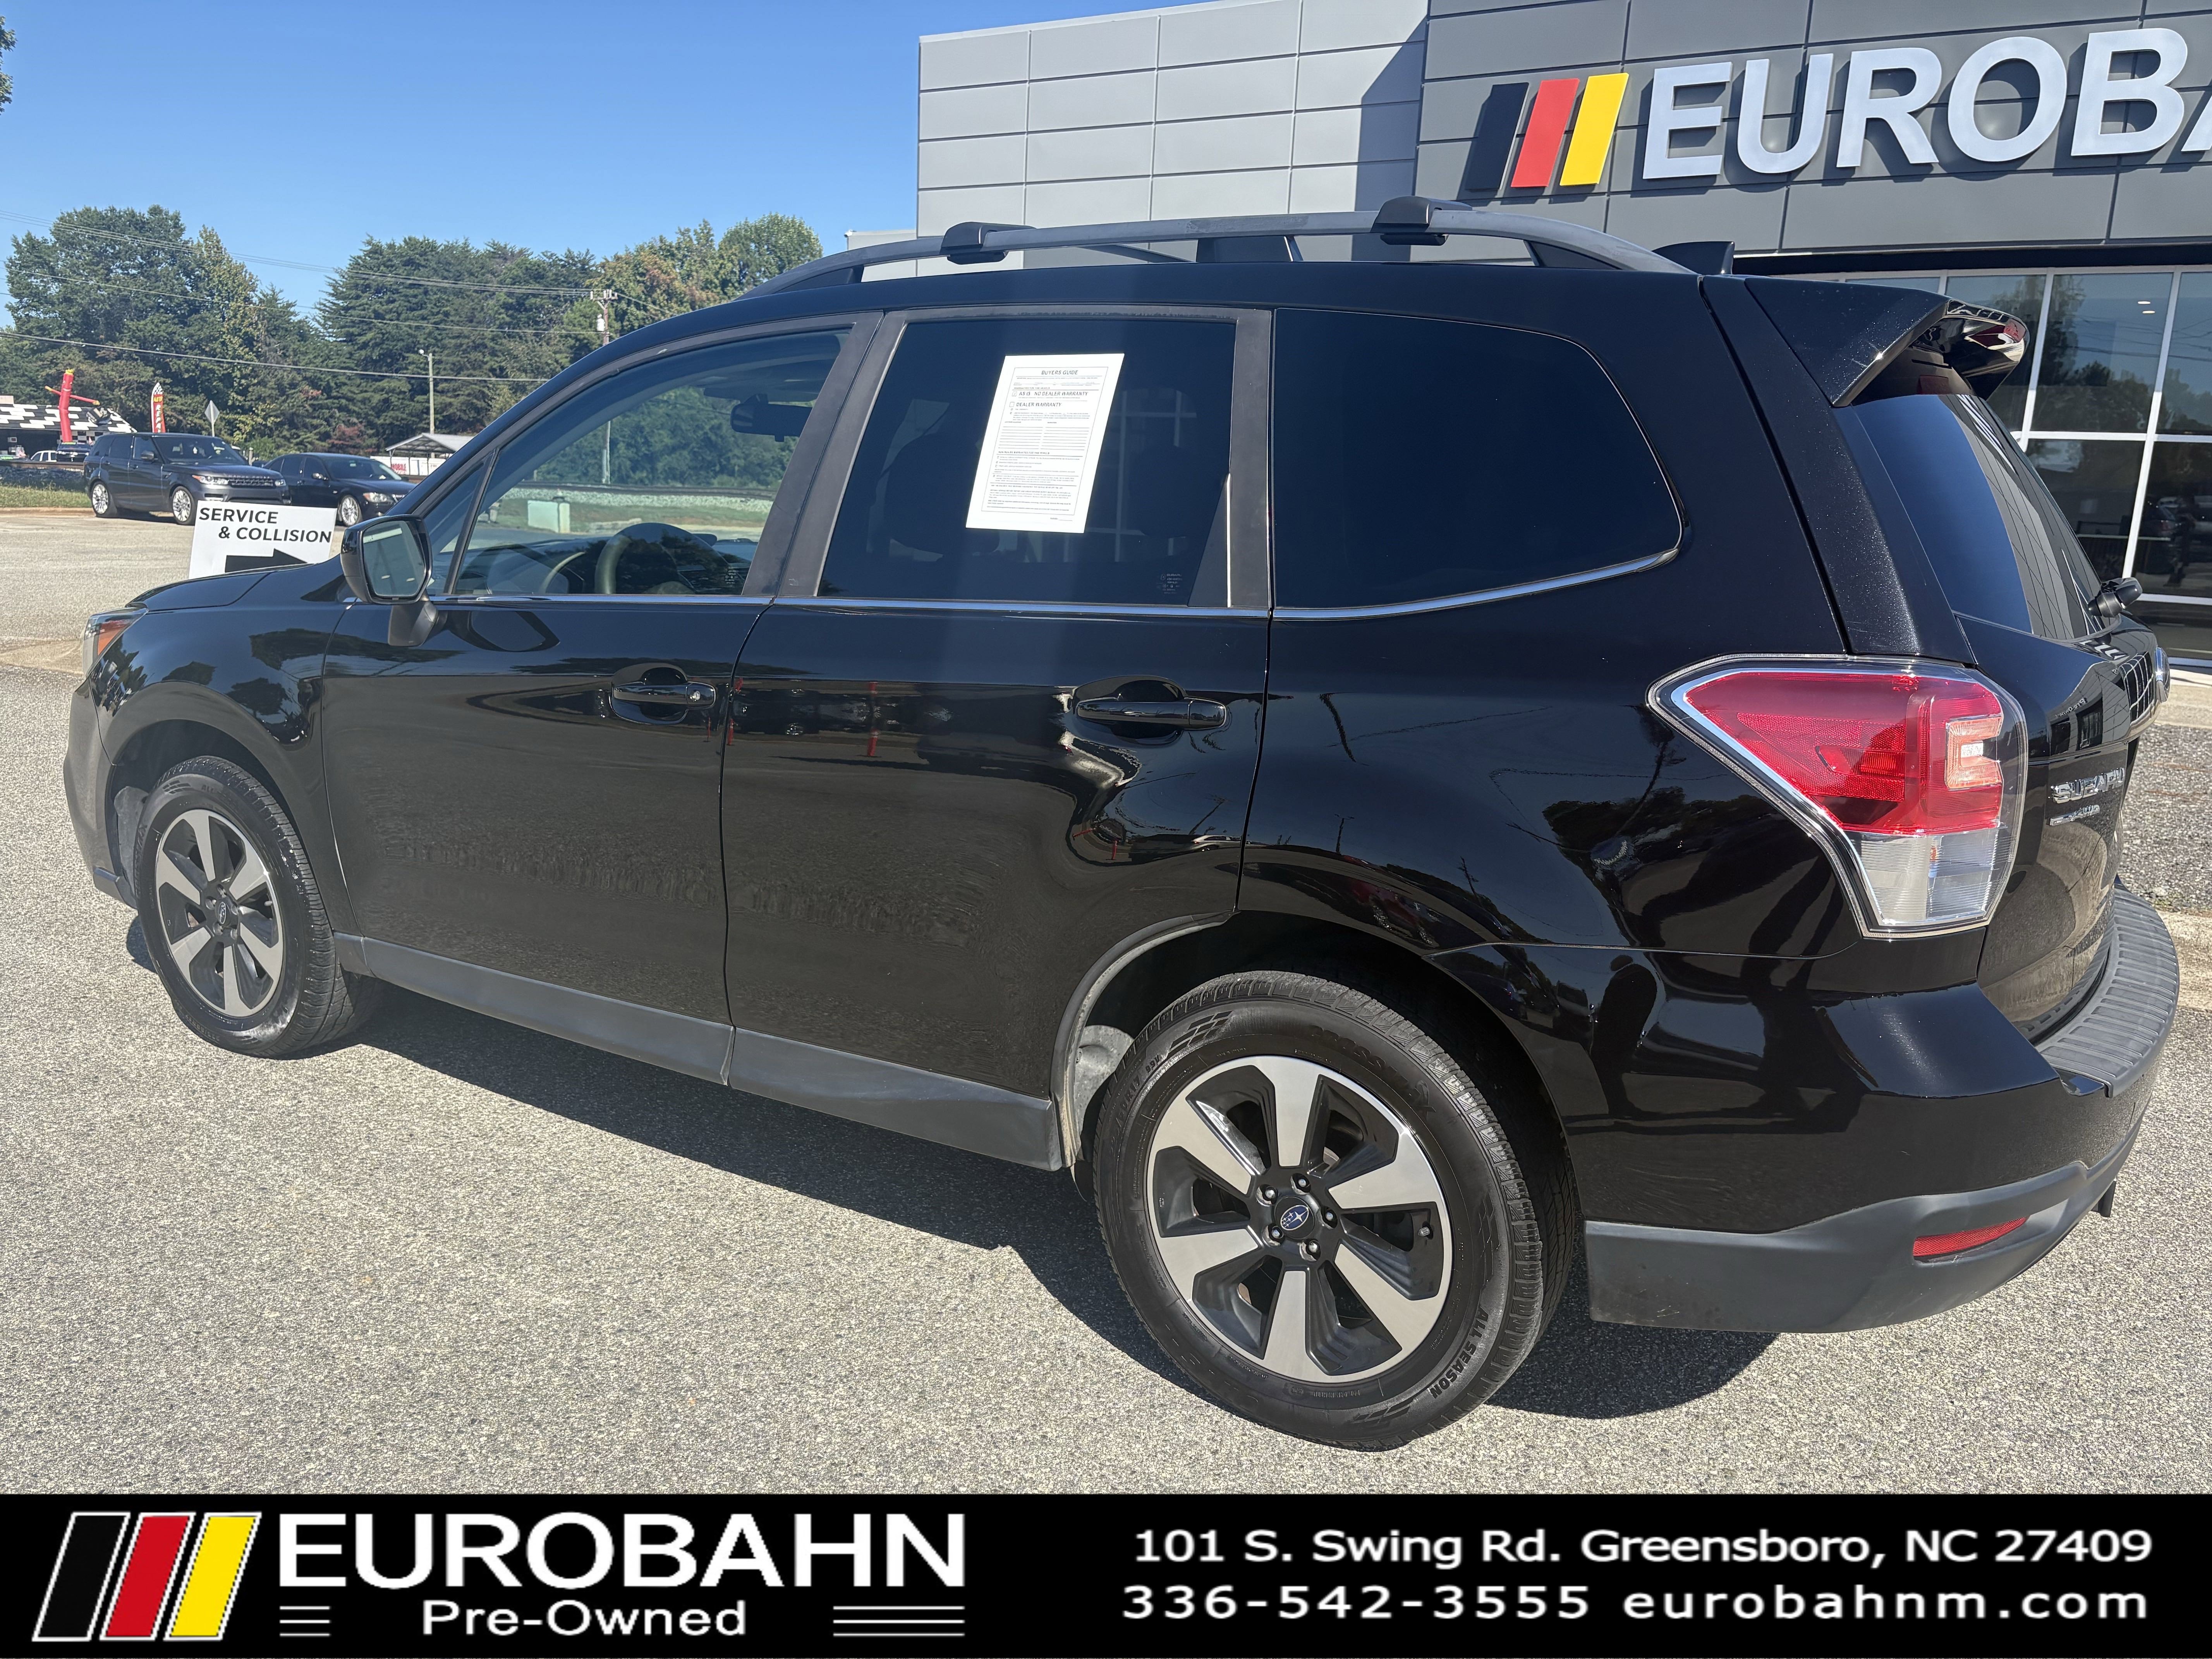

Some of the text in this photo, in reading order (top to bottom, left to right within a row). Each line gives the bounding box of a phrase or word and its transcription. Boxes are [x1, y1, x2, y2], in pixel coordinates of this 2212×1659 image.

[199, 507, 278, 524] SERVICE
[218, 526, 332, 543] & COLLISION
[1472, 1306, 1489, 1339] ALL
[1431, 1340, 1477, 1399] SEASON
